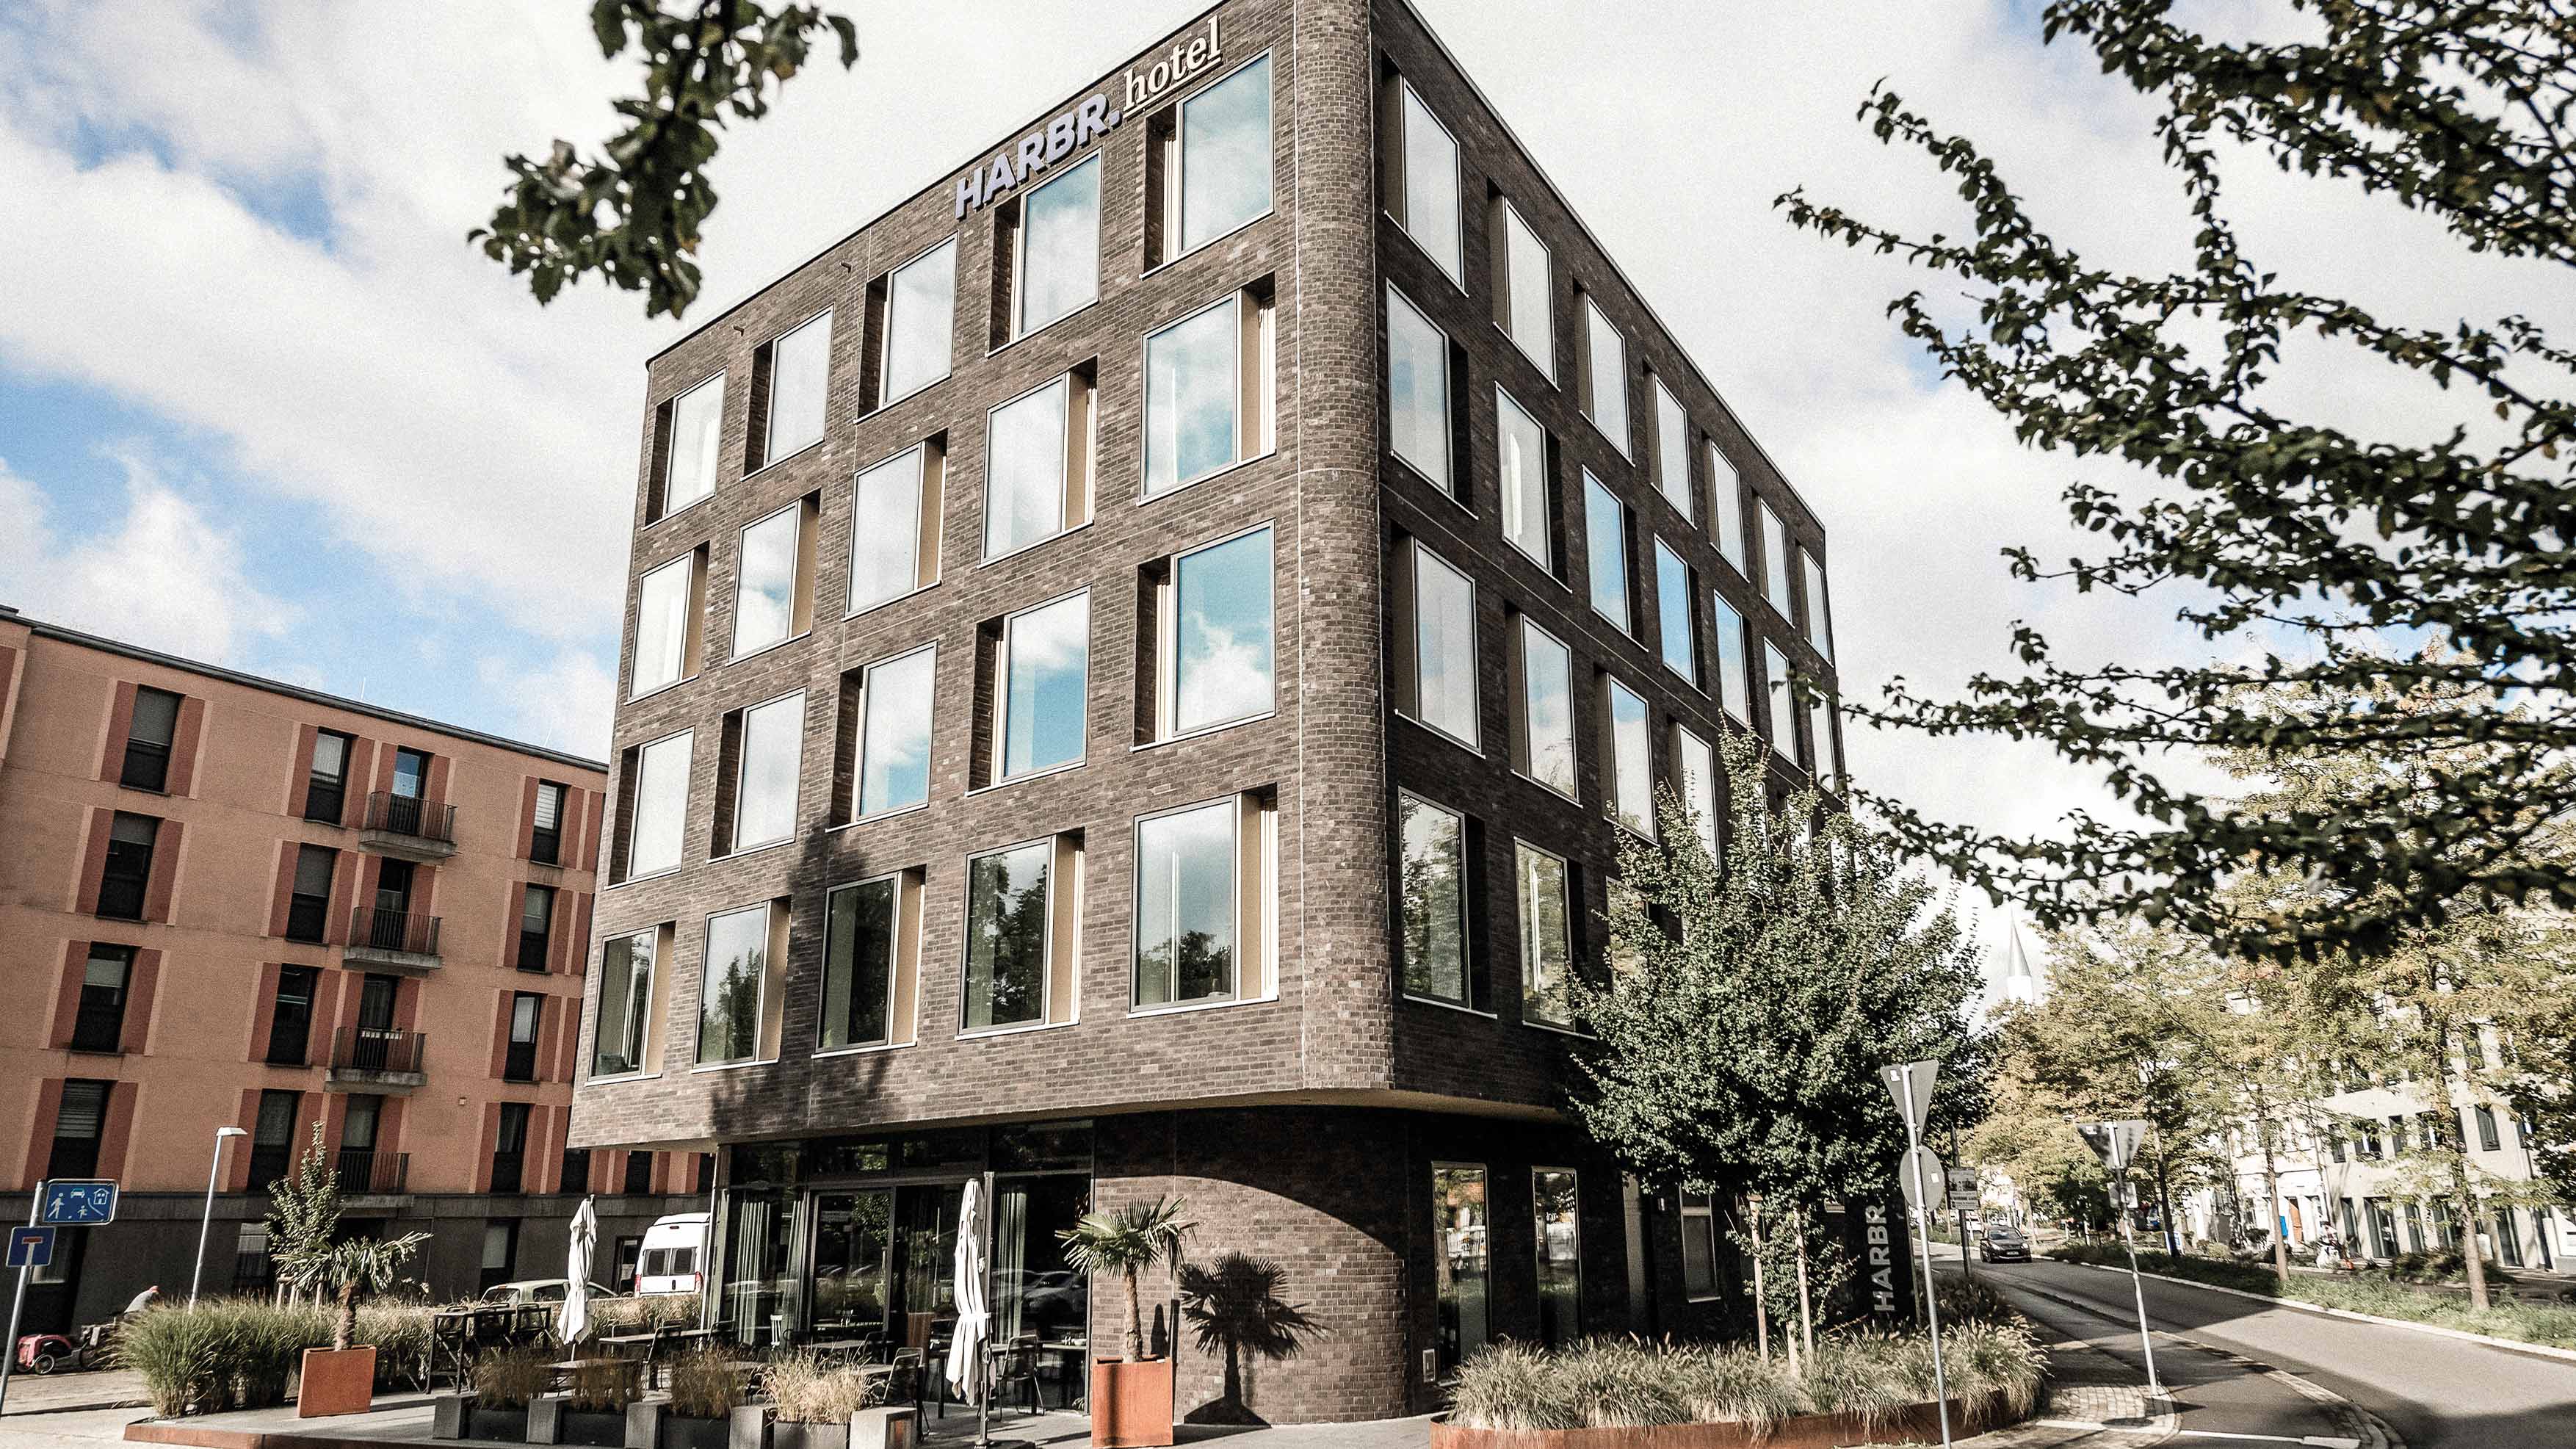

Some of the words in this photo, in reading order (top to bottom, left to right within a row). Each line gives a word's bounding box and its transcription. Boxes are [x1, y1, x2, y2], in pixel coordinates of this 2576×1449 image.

[955, 93, 1123, 220] HARBR.
[1124, 15, 1221, 112] hotel
[1865, 1205, 1895, 1311] HARBR
